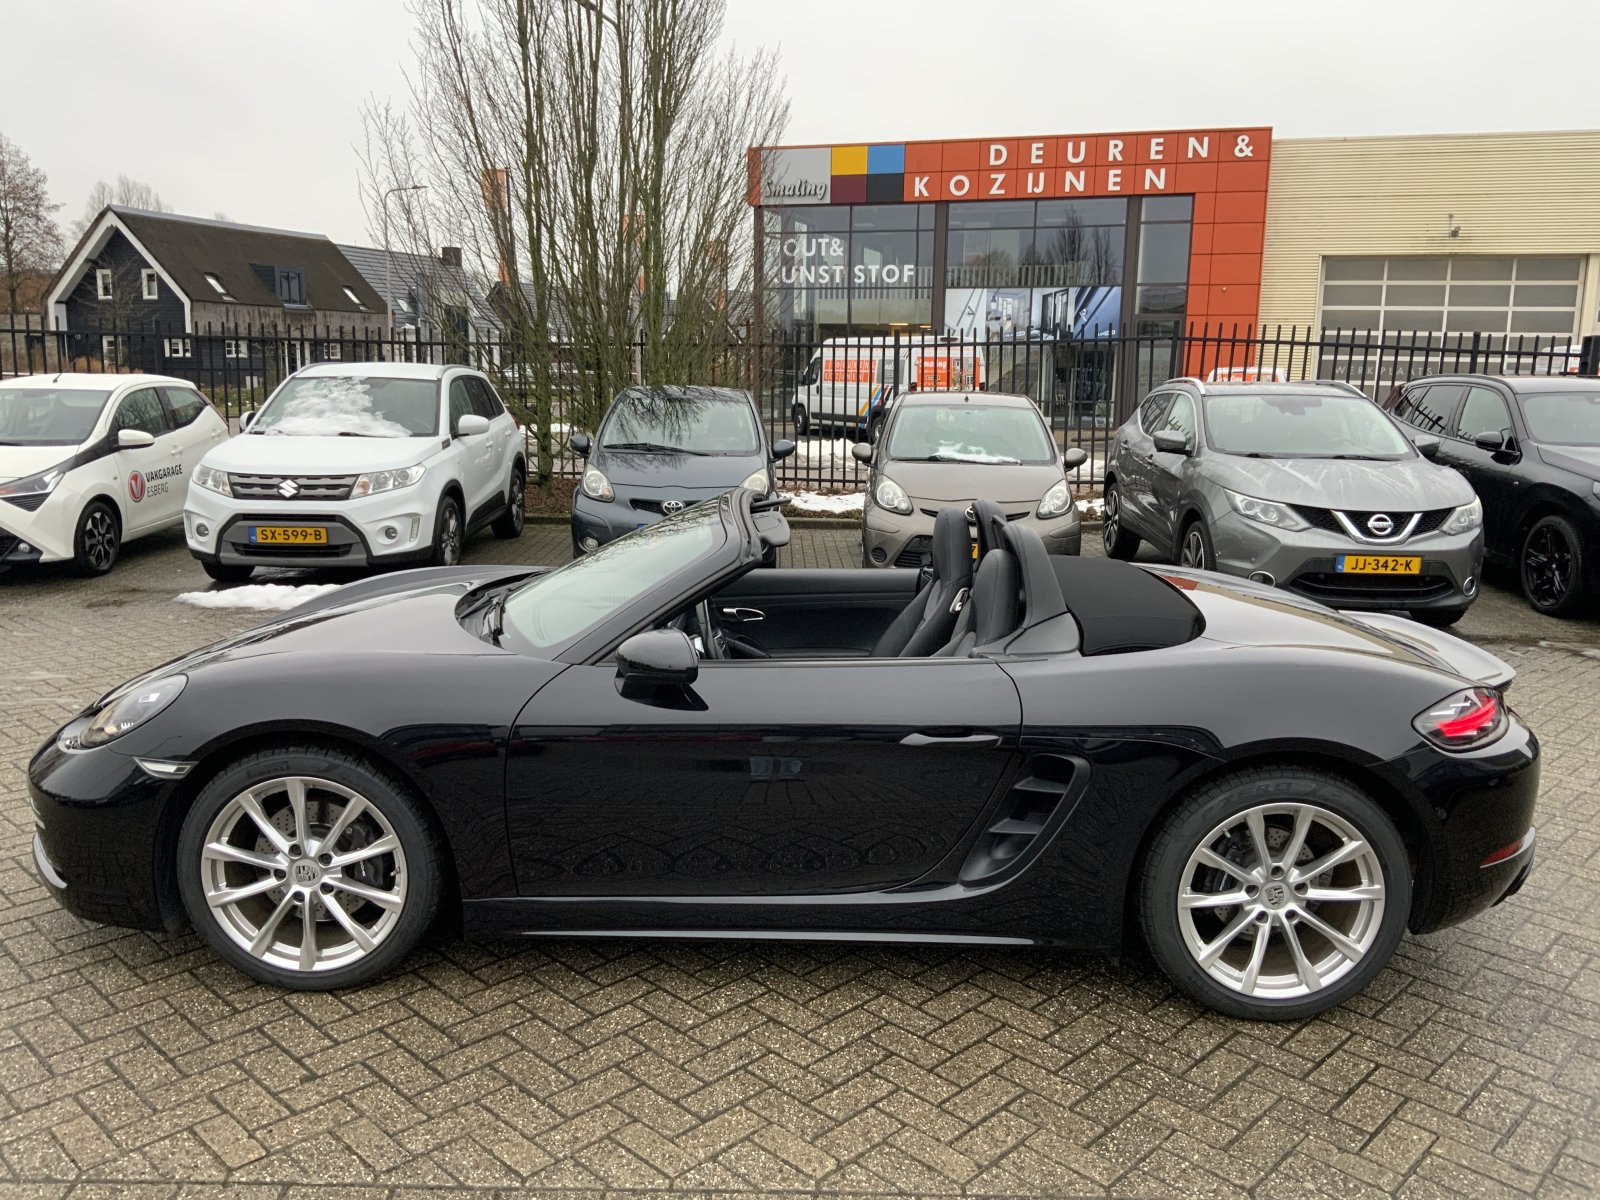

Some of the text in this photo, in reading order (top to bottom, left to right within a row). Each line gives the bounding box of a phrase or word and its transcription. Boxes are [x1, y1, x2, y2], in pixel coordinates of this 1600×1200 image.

[989, 134, 1254, 166] DEUREN &
[764, 179, 828, 201] Smaling
[914, 168, 1166, 198] KOZIJNEN
[782, 237, 844, 257] OUT&
[853, 264, 915, 284] STOF
[918, 358, 947, 370] maing
[145, 464, 183, 482] VAKGARAGE
[146, 481, 169, 498] ESBERG
[260, 529, 322, 541] SX-599-B
[1351, 558, 1413, 572] JJ-342-K
